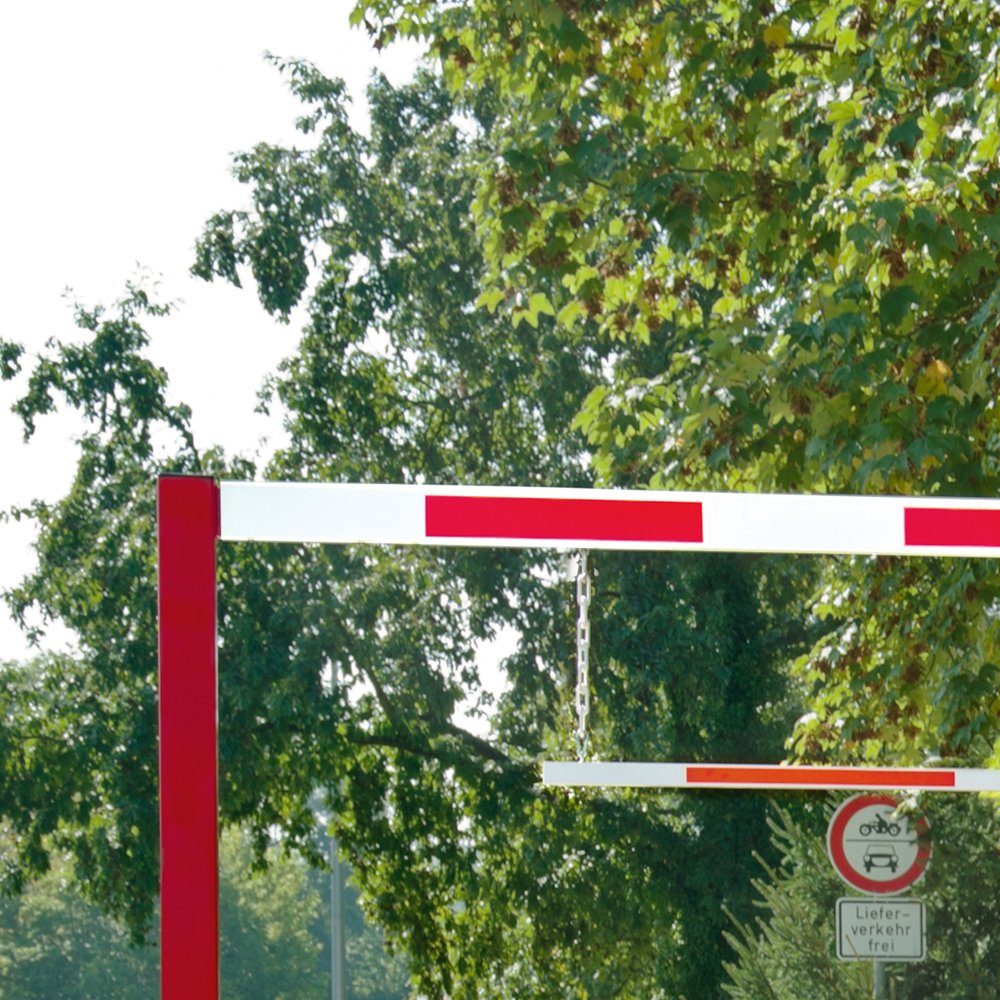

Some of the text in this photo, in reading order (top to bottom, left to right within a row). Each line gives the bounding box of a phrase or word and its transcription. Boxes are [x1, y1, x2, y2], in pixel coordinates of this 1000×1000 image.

[856, 906, 910, 919] Liefer-
[851, 923, 911, 935] verkehr
[868, 938, 895, 951] frei
